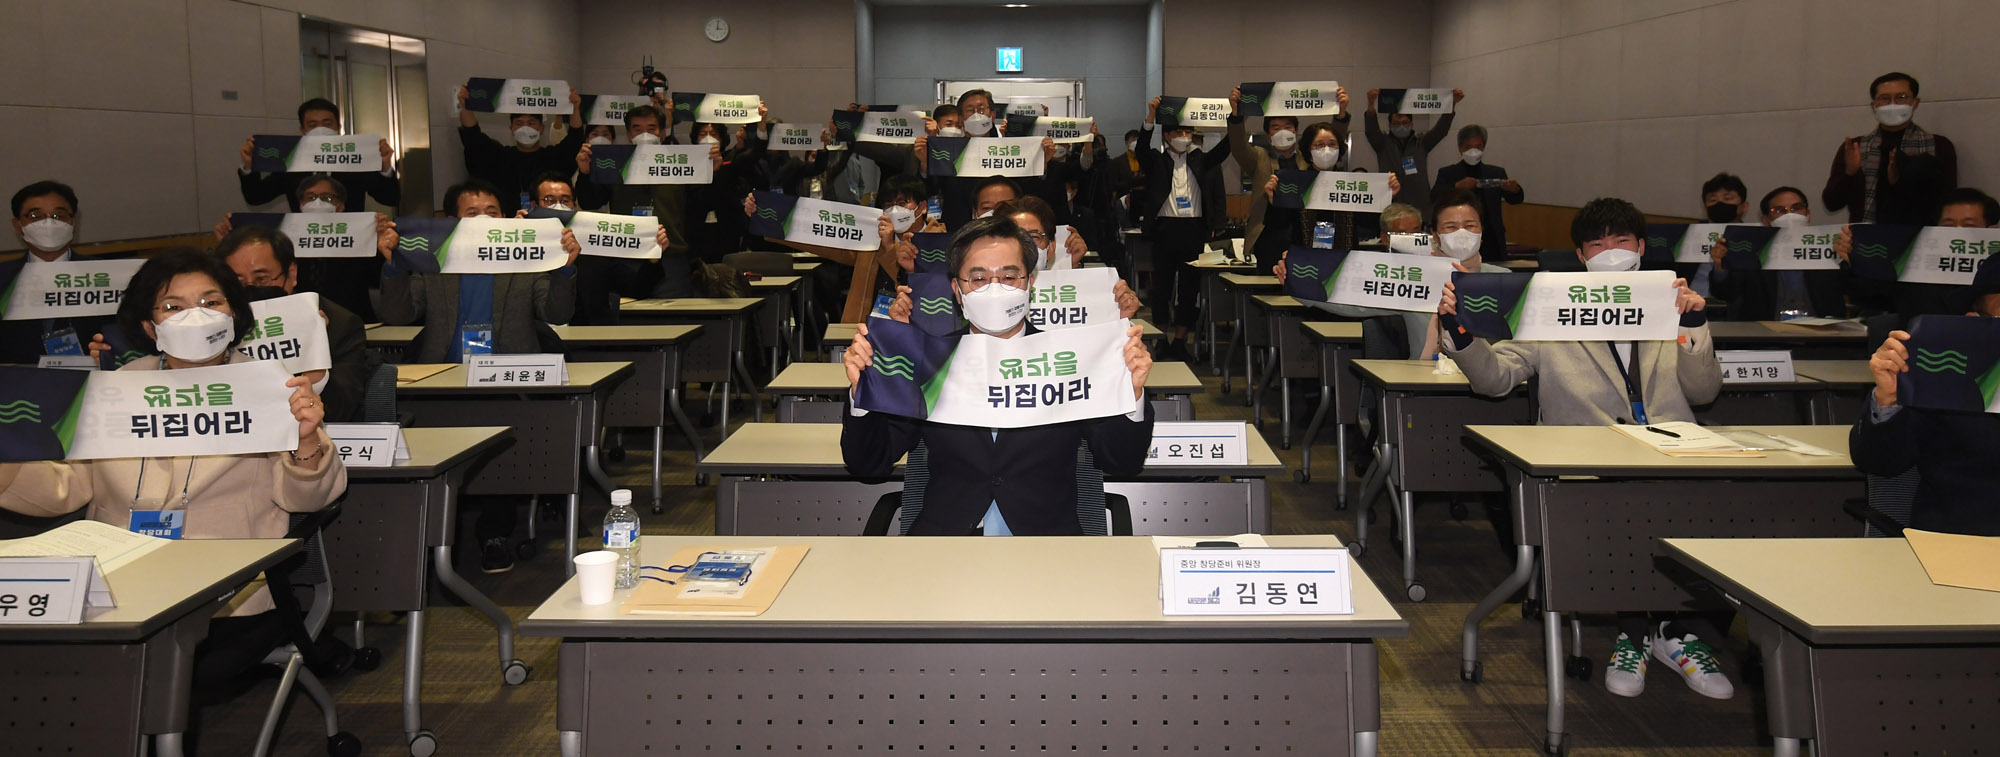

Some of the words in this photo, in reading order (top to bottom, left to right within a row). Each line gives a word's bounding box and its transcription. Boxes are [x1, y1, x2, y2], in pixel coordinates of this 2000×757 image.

[516, 97, 558, 108] 뒤집어라
[1284, 98, 1324, 110] 뒤집어라
[1413, 101, 1442, 110] 뒤집어라
[605, 110, 627, 119] 뒤집
[713, 109, 748, 118] 뒤집어라
[876, 127, 914, 138] 뒤집어라
[1046, 129, 1081, 138] 뒤집어라
[781, 137, 812, 145] 뒤집어라
[313, 154, 363, 165] 뒤집어라
[981, 157, 1027, 169] 뒤집어라
[648, 165, 695, 177] 뒤집어라
[1328, 191, 1374, 205] 뒤집어라
[811, 222, 864, 242] 뒤집어라
[298, 236, 355, 249] 뒤집어라
[588, 234, 641, 249] 뒤집어라
[477, 246, 546, 261] 뒤집어라
[1793, 247, 1838, 260] 뒤집어
[1938, 257, 1984, 274] 뒤집
[1363, 280, 1431, 300] 뒤집어라
[44, 289, 123, 307] 뒤집어라
[1029, 306, 1088, 326] 집어라
[1557, 307, 1644, 327] 뒤집어라
[987, 376, 1092, 409] 뒤집어라
[131, 411, 252, 439] 뒤집어라
[338, 446, 373, 461] 우식
[1180, 559, 1197, 569] 중앙
[1236, 559, 1261, 569] 위원장
